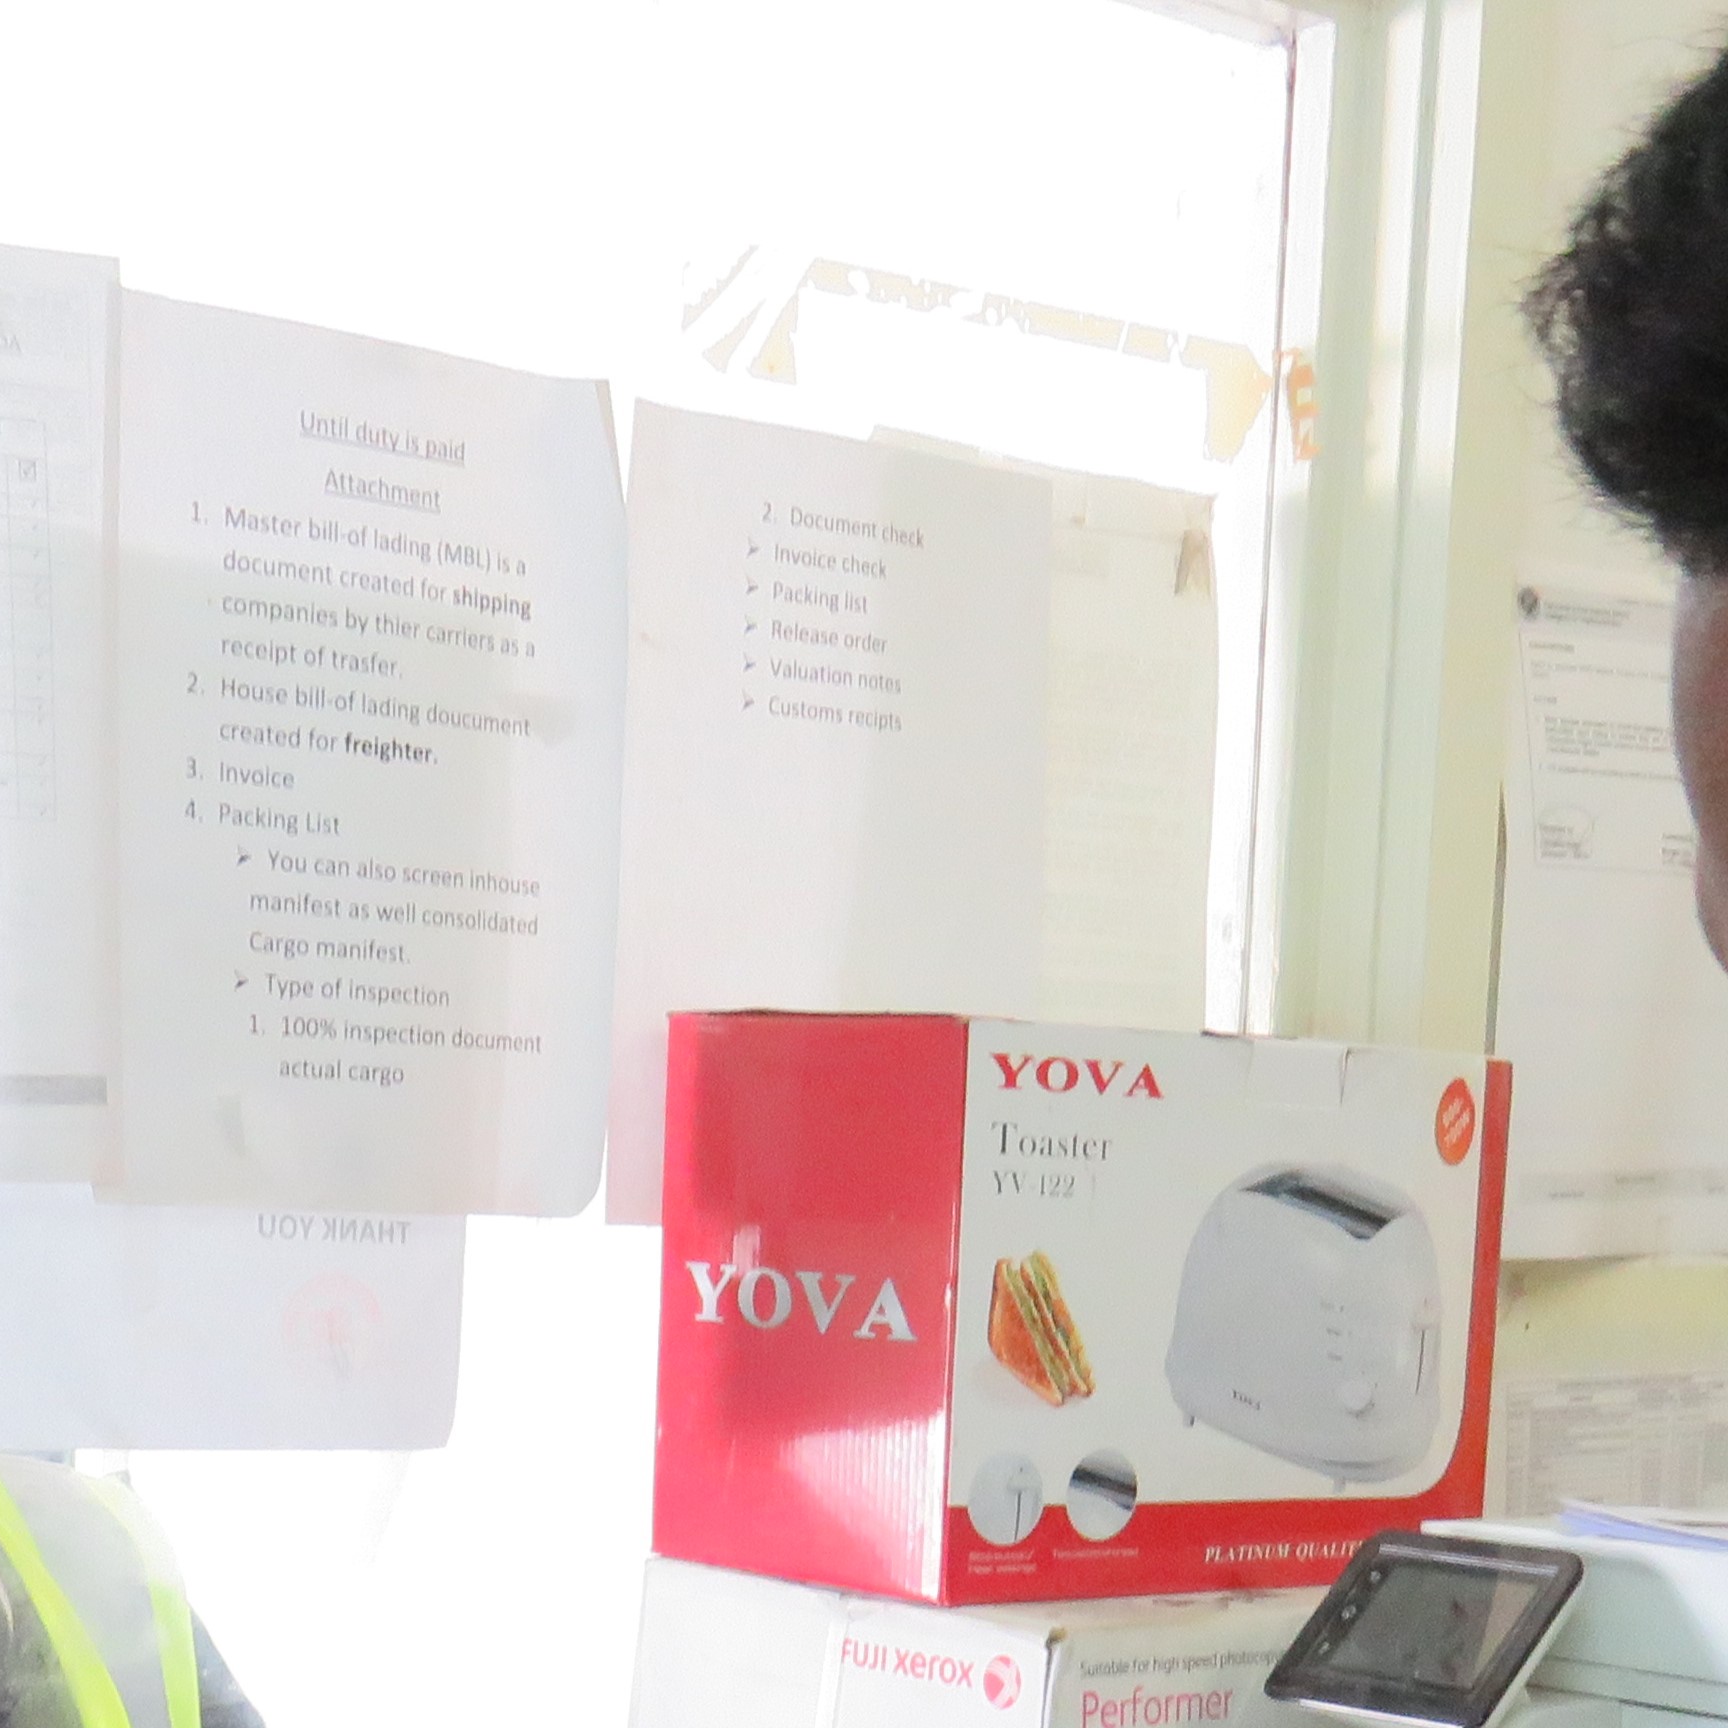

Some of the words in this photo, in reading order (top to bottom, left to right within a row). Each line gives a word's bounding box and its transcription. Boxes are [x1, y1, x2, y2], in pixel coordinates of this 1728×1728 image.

[300, 409, 349, 438] Until
[356, 423, 399, 452] duty
[406, 430, 419, 451] is
[426, 439, 465, 461] paid
[325, 469, 440, 508] Attachment
[224, 505, 302, 538] Master
[374, 530, 431, 563] lading
[436, 540, 490, 573] (MBL)
[496, 553, 511, 573] is
[516, 559, 526, 576] a
[790, 506, 877, 540] Document
[882, 522, 924, 548] check
[774, 544, 837, 571] Invoice
[842, 554, 887, 579] check
[224, 550, 332, 585] document
[340, 569, 415, 597] created
[422, 578, 447, 602] for
[453, 586, 531, 621] shipping
[773, 582, 839, 613] Packing
[844, 589, 868, 614] list
[222, 595, 338, 627] companies
[345, 610, 369, 634] by
[375, 614, 421, 639] thier
[426, 625, 494, 653] carriers
[500, 640, 520, 655] as
[526, 643, 535, 658] a
[771, 620, 839, 648] Release
[844, 629, 888, 654] order
[221, 637, 297, 666] receipt
[304, 647, 326, 667] of
[770, 659, 852, 687] Valuation
[858, 670, 902, 694] notes
[221, 677, 288, 705] House
[361, 693, 421, 725] lading
[426, 703, 531, 738] doucument
[769, 696, 842, 724] Customs
[848, 707, 902, 732] recipts
[220, 723, 301, 749] created
[309, 728, 339, 752] for
[345, 733, 438, 765] freighter.
[219, 762, 295, 790] Invoice
[218, 803, 299, 836] Packing
[306, 813, 341, 834] List
[268, 849, 307, 874] You
[314, 855, 350, 877] can
[356, 859, 396, 882] also
[402, 866, 464, 888] screen
[470, 870, 541, 895] inhouse
[250, 893, 341, 917] manifest
[349, 903, 370, 920] as
[377, 903, 416, 924] well
[422, 907, 538, 936] consolidated
[249, 932, 310, 958] Cargo
[317, 938, 411, 963] manifest.
[266, 973, 314, 999] Type
[321, 979, 345, 998] of
[349, 979, 450, 1008] inspection
[281, 1017, 337, 1040] 100%
[344, 1020, 445, 1048] inspection
[451, 1027, 542, 1054] document
[279, 1059, 342, 1079] actual
[349, 1064, 404, 1086] cargo
[990, 1053, 1165, 1099] YOVA
[991, 1122, 1112, 1161] Toaster
[685, 1261, 917, 1343] YOVA
[1204, 1544, 1290, 1564] PLATINUM
[841, 1637, 887, 1672] FUJI
